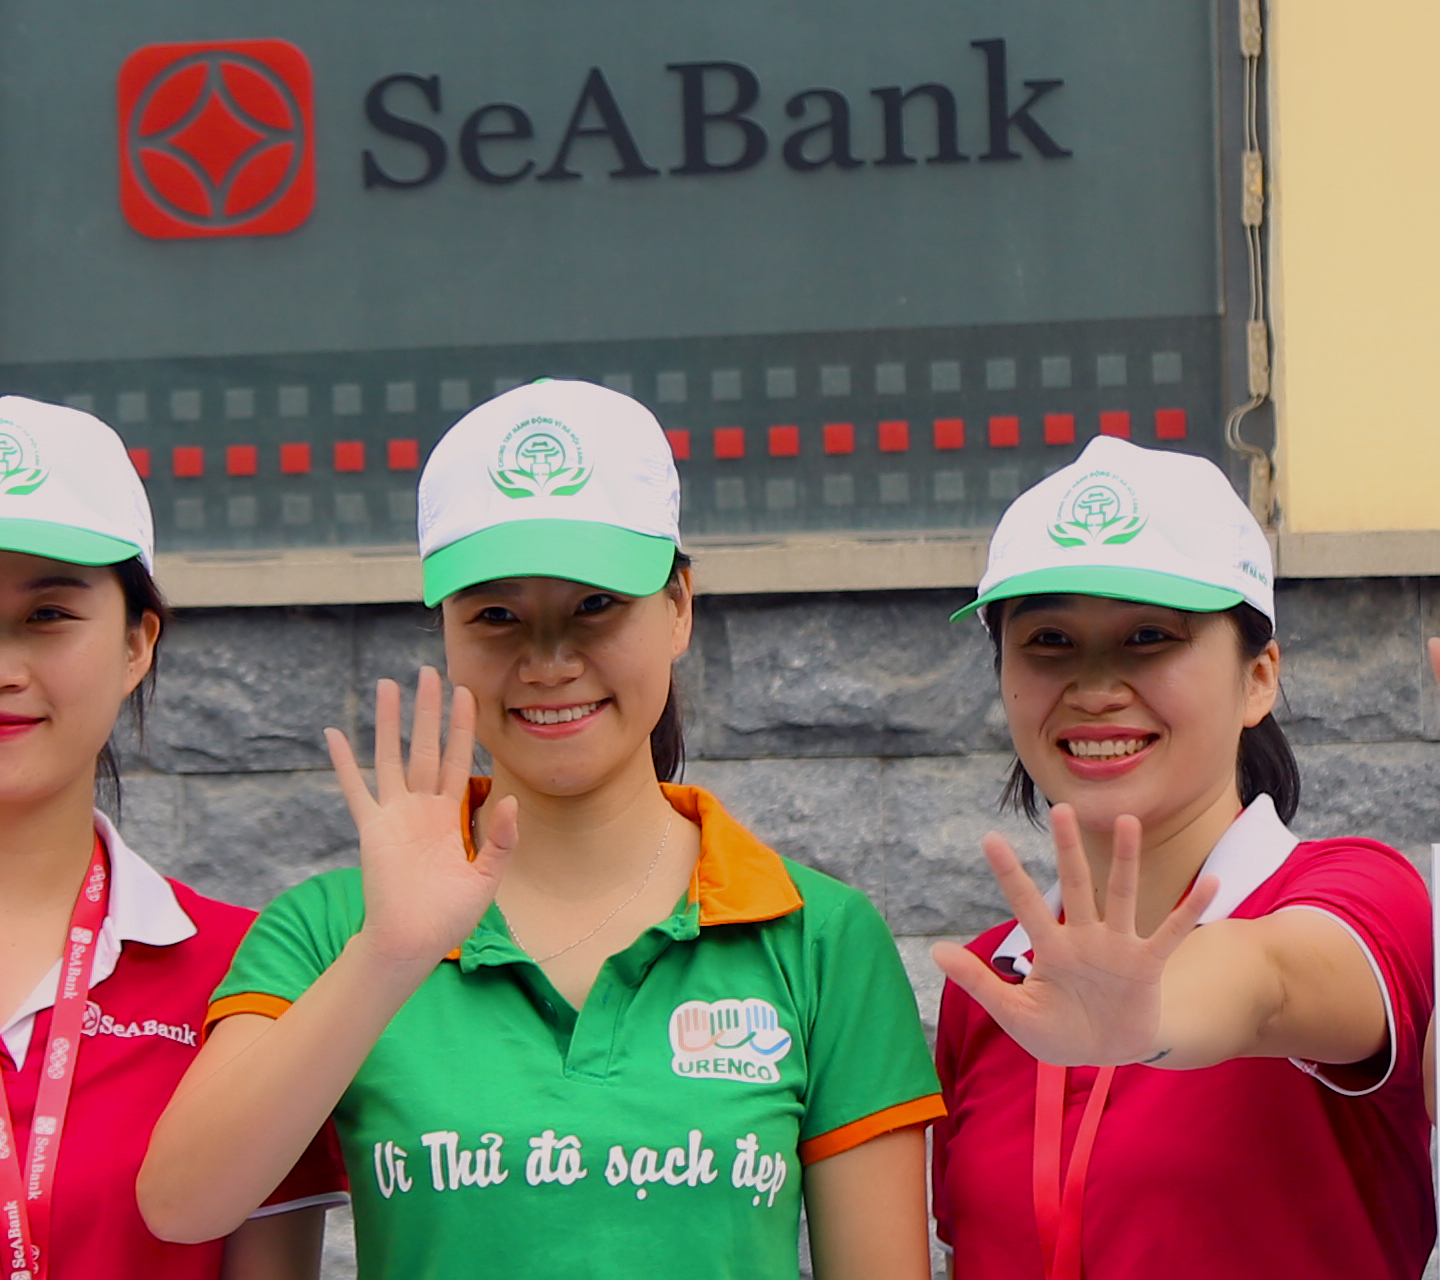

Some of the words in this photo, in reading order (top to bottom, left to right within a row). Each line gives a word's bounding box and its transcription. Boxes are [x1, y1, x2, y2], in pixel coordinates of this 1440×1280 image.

[359, 37, 1071, 192] SeABank
[63, 943, 86, 1000] SeABank
[100, 1010, 197, 1047] SeABank
[677, 1057, 773, 1081] URENCO
[27, 1137, 50, 1201] SeABank
[421, 1131, 509, 1192] Thủ
[525, 1129, 587, 1187] đô
[605, 1129, 718, 1200] sạch
[731, 1132, 787, 1208] đẹp
[3, 1200, 27, 1268] SeABank
